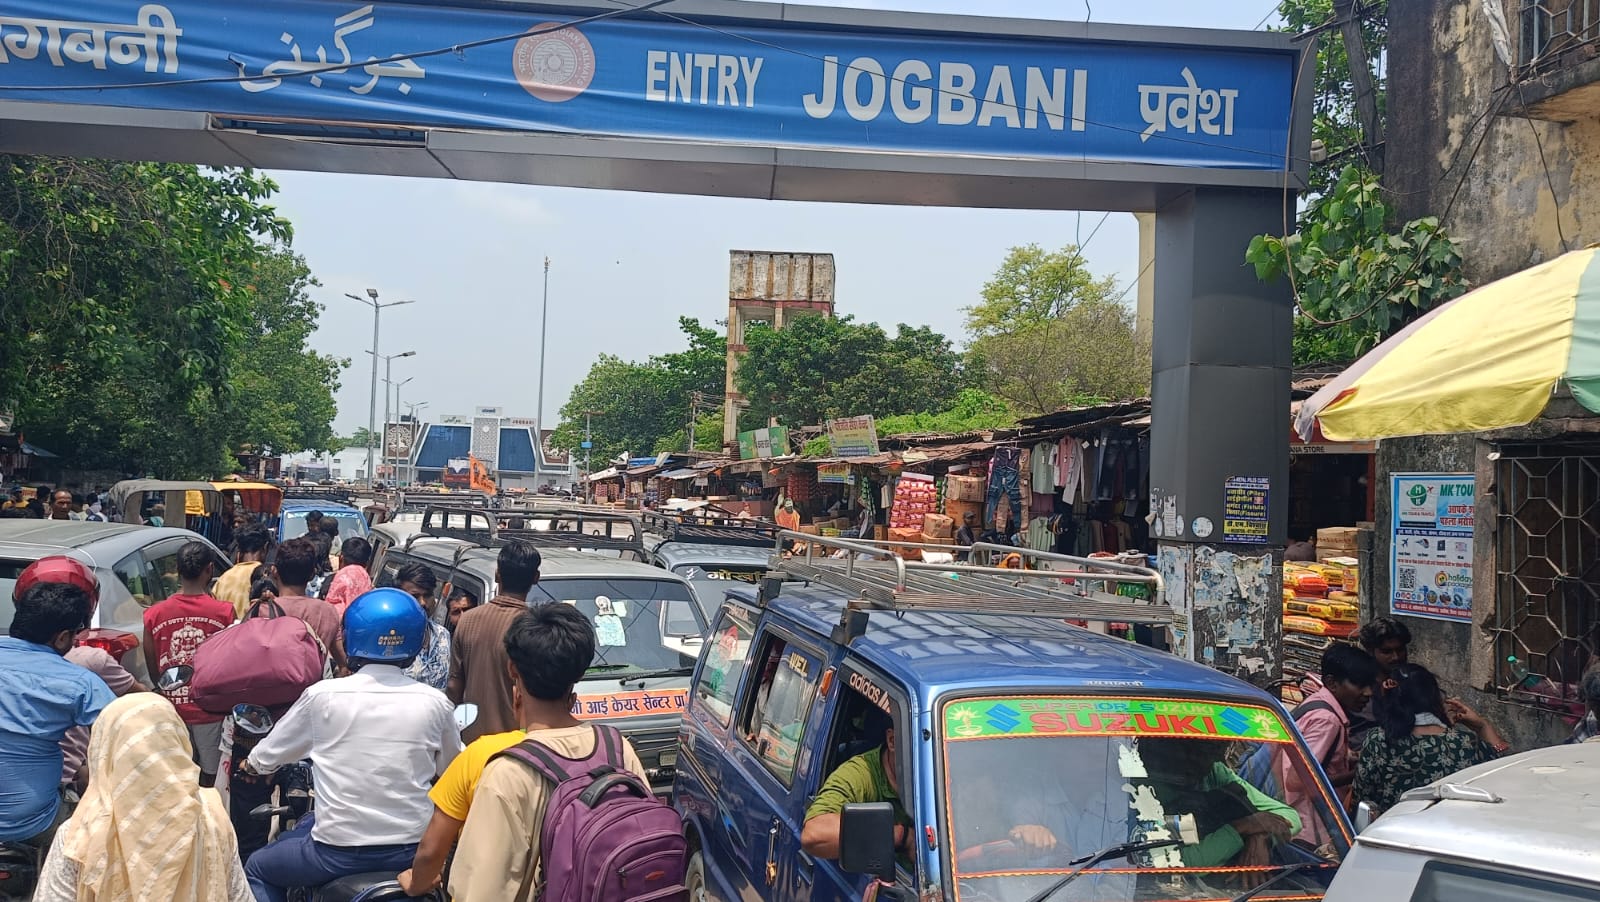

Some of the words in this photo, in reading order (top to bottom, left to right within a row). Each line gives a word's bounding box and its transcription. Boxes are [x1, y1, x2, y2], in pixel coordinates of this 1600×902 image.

[645, 50, 763, 109] ENTRY
[803, 54, 1088, 132] JOGBANI
[1138, 67, 1239, 143] प्रवेश
[849, 672, 881, 703] adidas
[587, 697, 609, 715] आई
[611, 696, 641, 714] केयर
[1018, 701, 1129, 712] SUPERIOR
[1140, 703, 1215, 714] SUZUKI
[1031, 713, 1218, 734] SUZUKI
